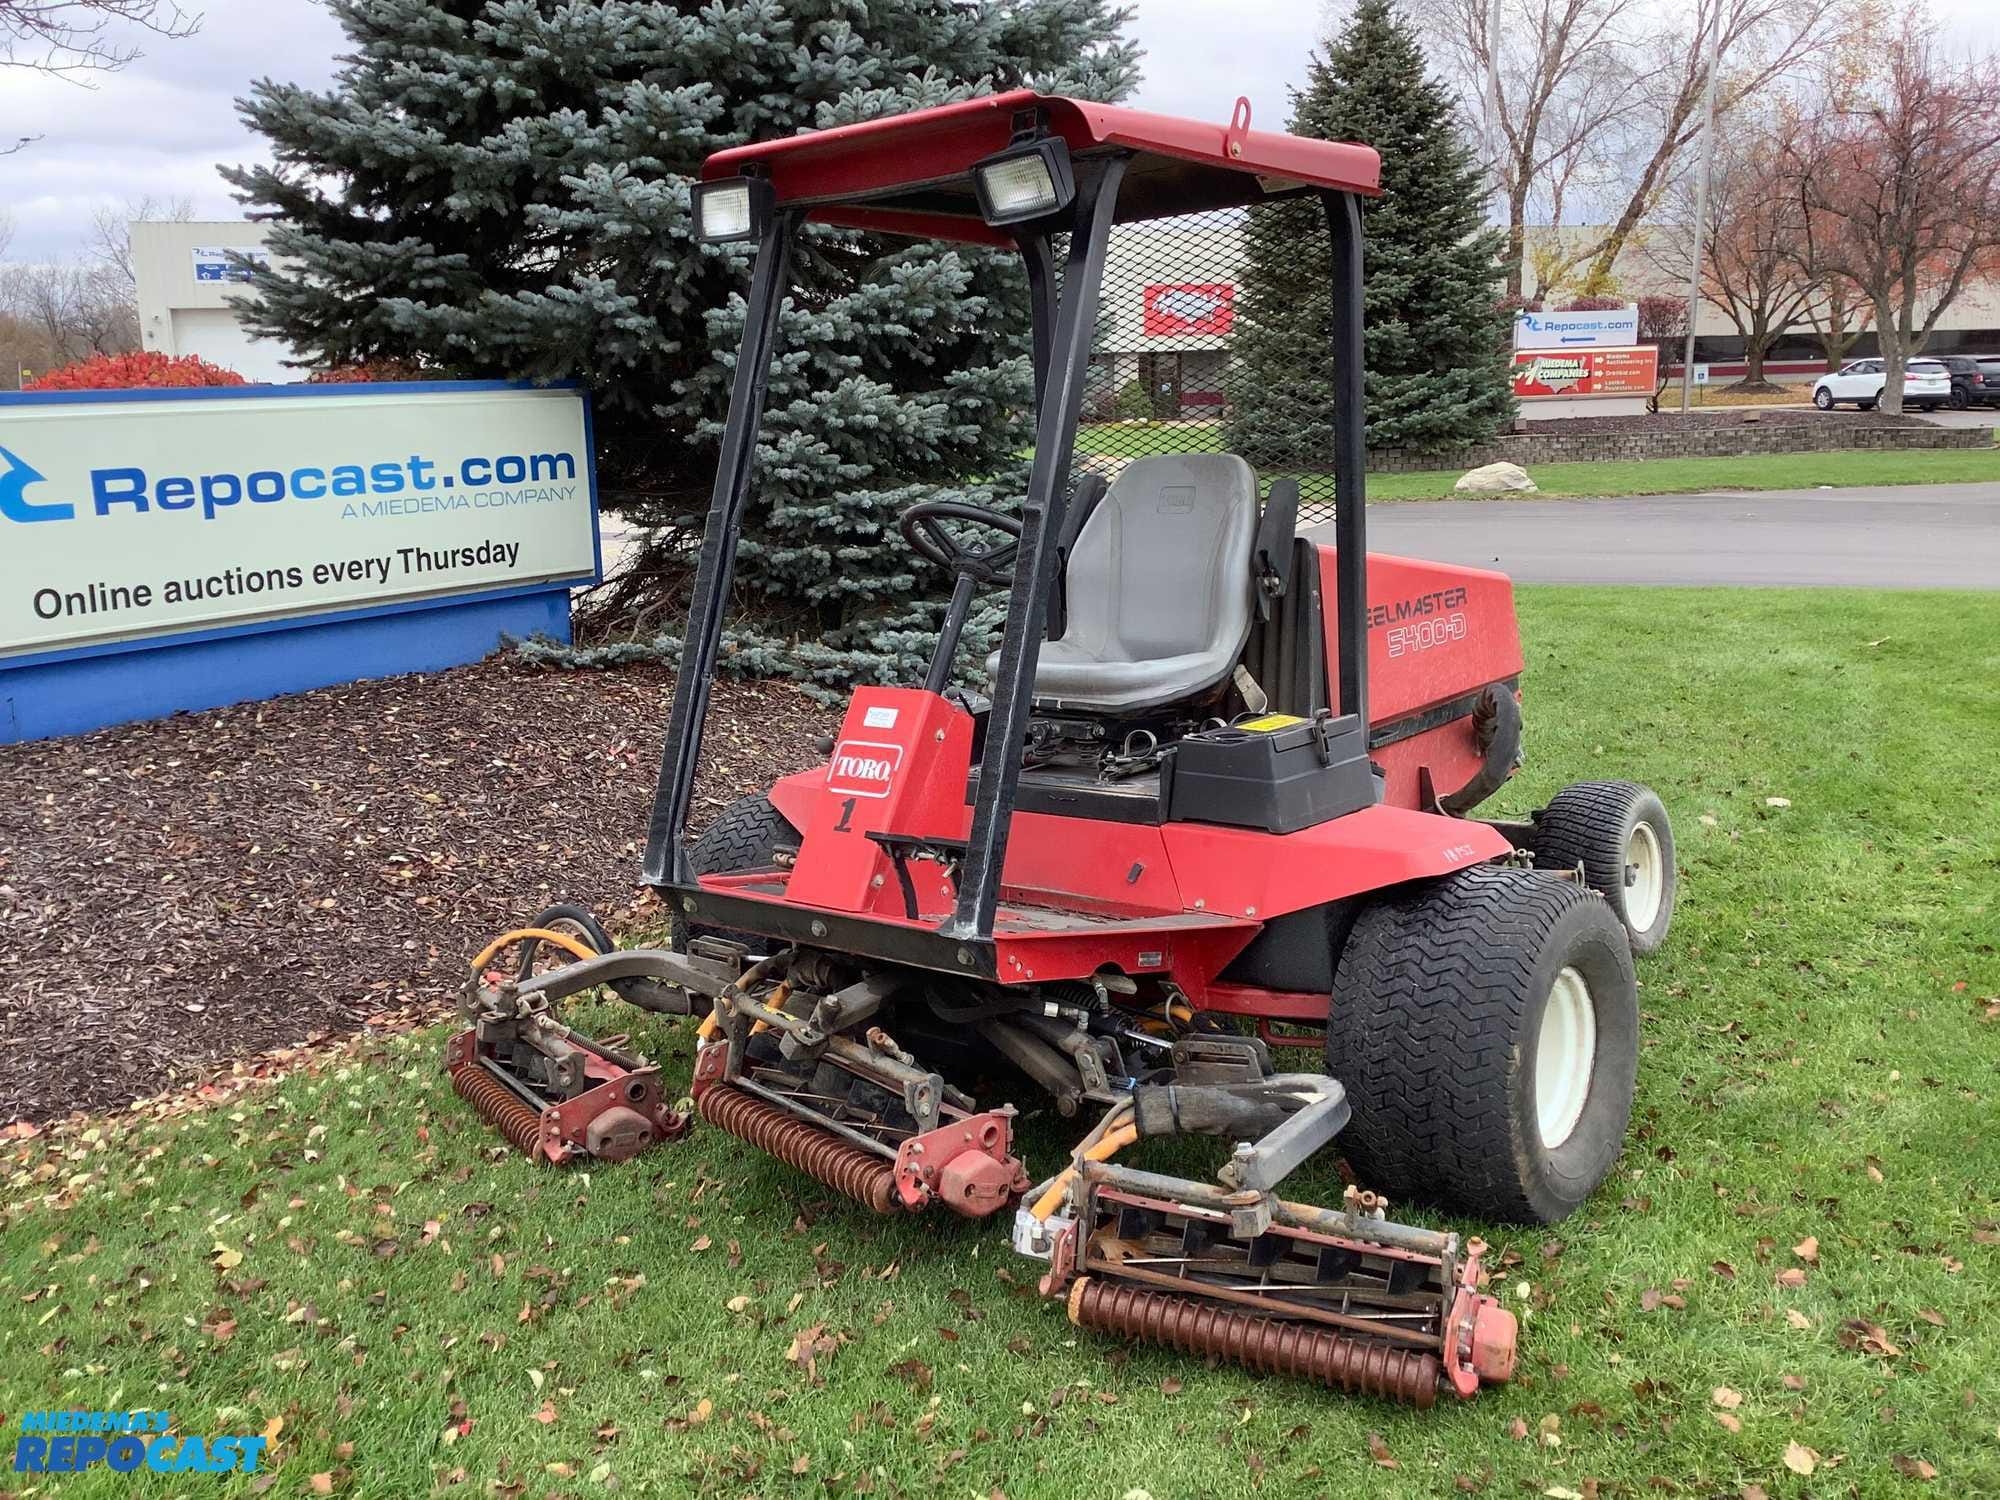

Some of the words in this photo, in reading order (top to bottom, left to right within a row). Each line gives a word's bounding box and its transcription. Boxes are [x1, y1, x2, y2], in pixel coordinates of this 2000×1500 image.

[1545, 321, 1633, 332] Repocast.com
[1537, 368, 1589, 380] COMPANIES
[1540, 359, 1579, 369] MIEDEMA
[90, 452, 576, 520] Repocast.com
[341, 503, 359, 519] A
[362, 495, 470, 518] MIEDEMA
[473, 486, 577, 509] COMPANY
[33, 582, 153, 620] Online
[164, 566, 303, 604] auctions
[312, 556, 391, 584] every
[396, 539, 520, 575] Thursday
[1387, 613, 1467, 658] 5400-D
[837, 756, 891, 782] TORO
[833, 798, 857, 832] 1
